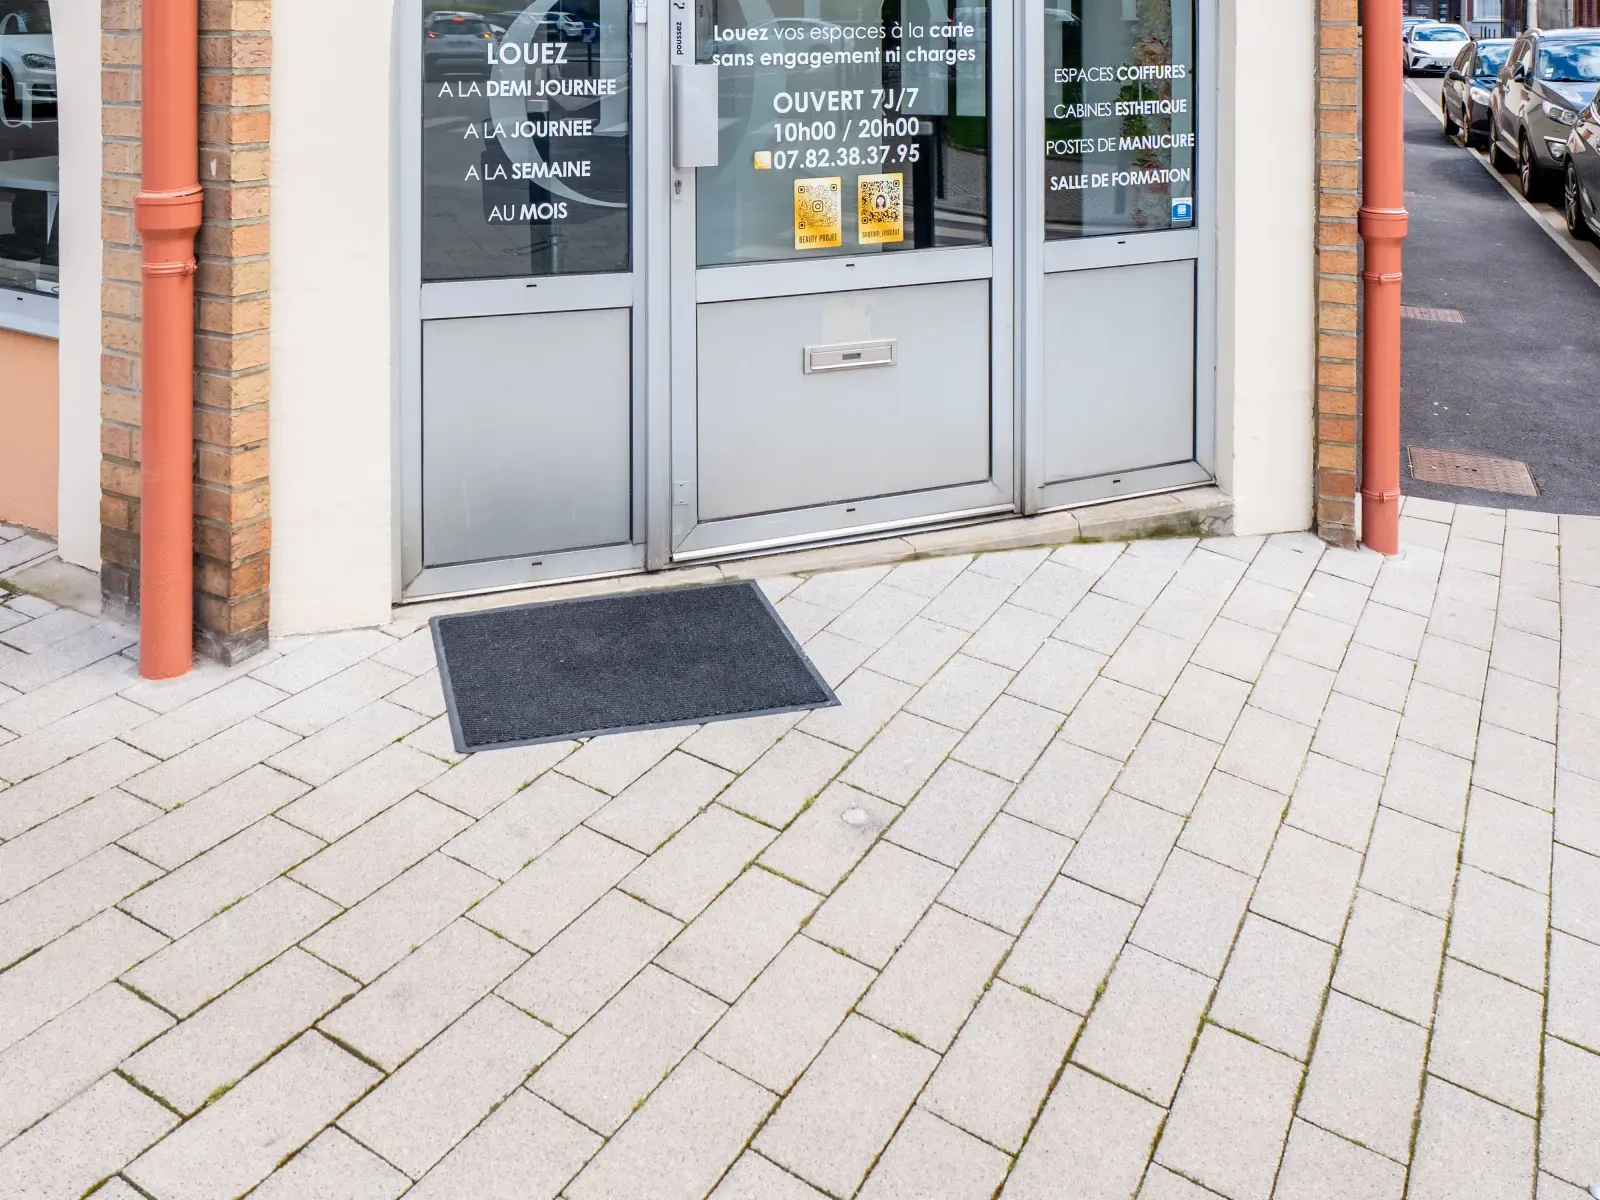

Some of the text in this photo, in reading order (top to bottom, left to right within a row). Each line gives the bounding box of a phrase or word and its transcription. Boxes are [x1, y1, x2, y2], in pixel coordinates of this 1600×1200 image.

[676, 21, 684, 56] poussez
[715, 22, 974, 43] Louez vos espaces à la carte
[488, 43, 567, 64] LOUEZ
[712, 46, 975, 68] sans engagement ni charges
[1055, 65, 1185, 82] ESPACES COIFFURES
[439, 79, 616, 97] A LA DEMI JOURNEE
[774, 88, 918, 113] OUVERT 7J/7
[1054, 99, 1186, 118] CABINES ESTHETIQUE
[464, 120, 591, 138] A LA JOURNEE
[774, 117, 919, 142] 10h00 / 20h00
[1047, 134, 1194, 154] POSTES DE MANUCURE
[774, 144, 919, 169] 07.82.38.37.95
[465, 161, 590, 180] A LA SEMAINE
[1051, 168, 1190, 190] SALLE DE FORMATION
[488, 203, 567, 221] AU MOIS
[799, 233, 838, 244] BEAUTY PROJET
